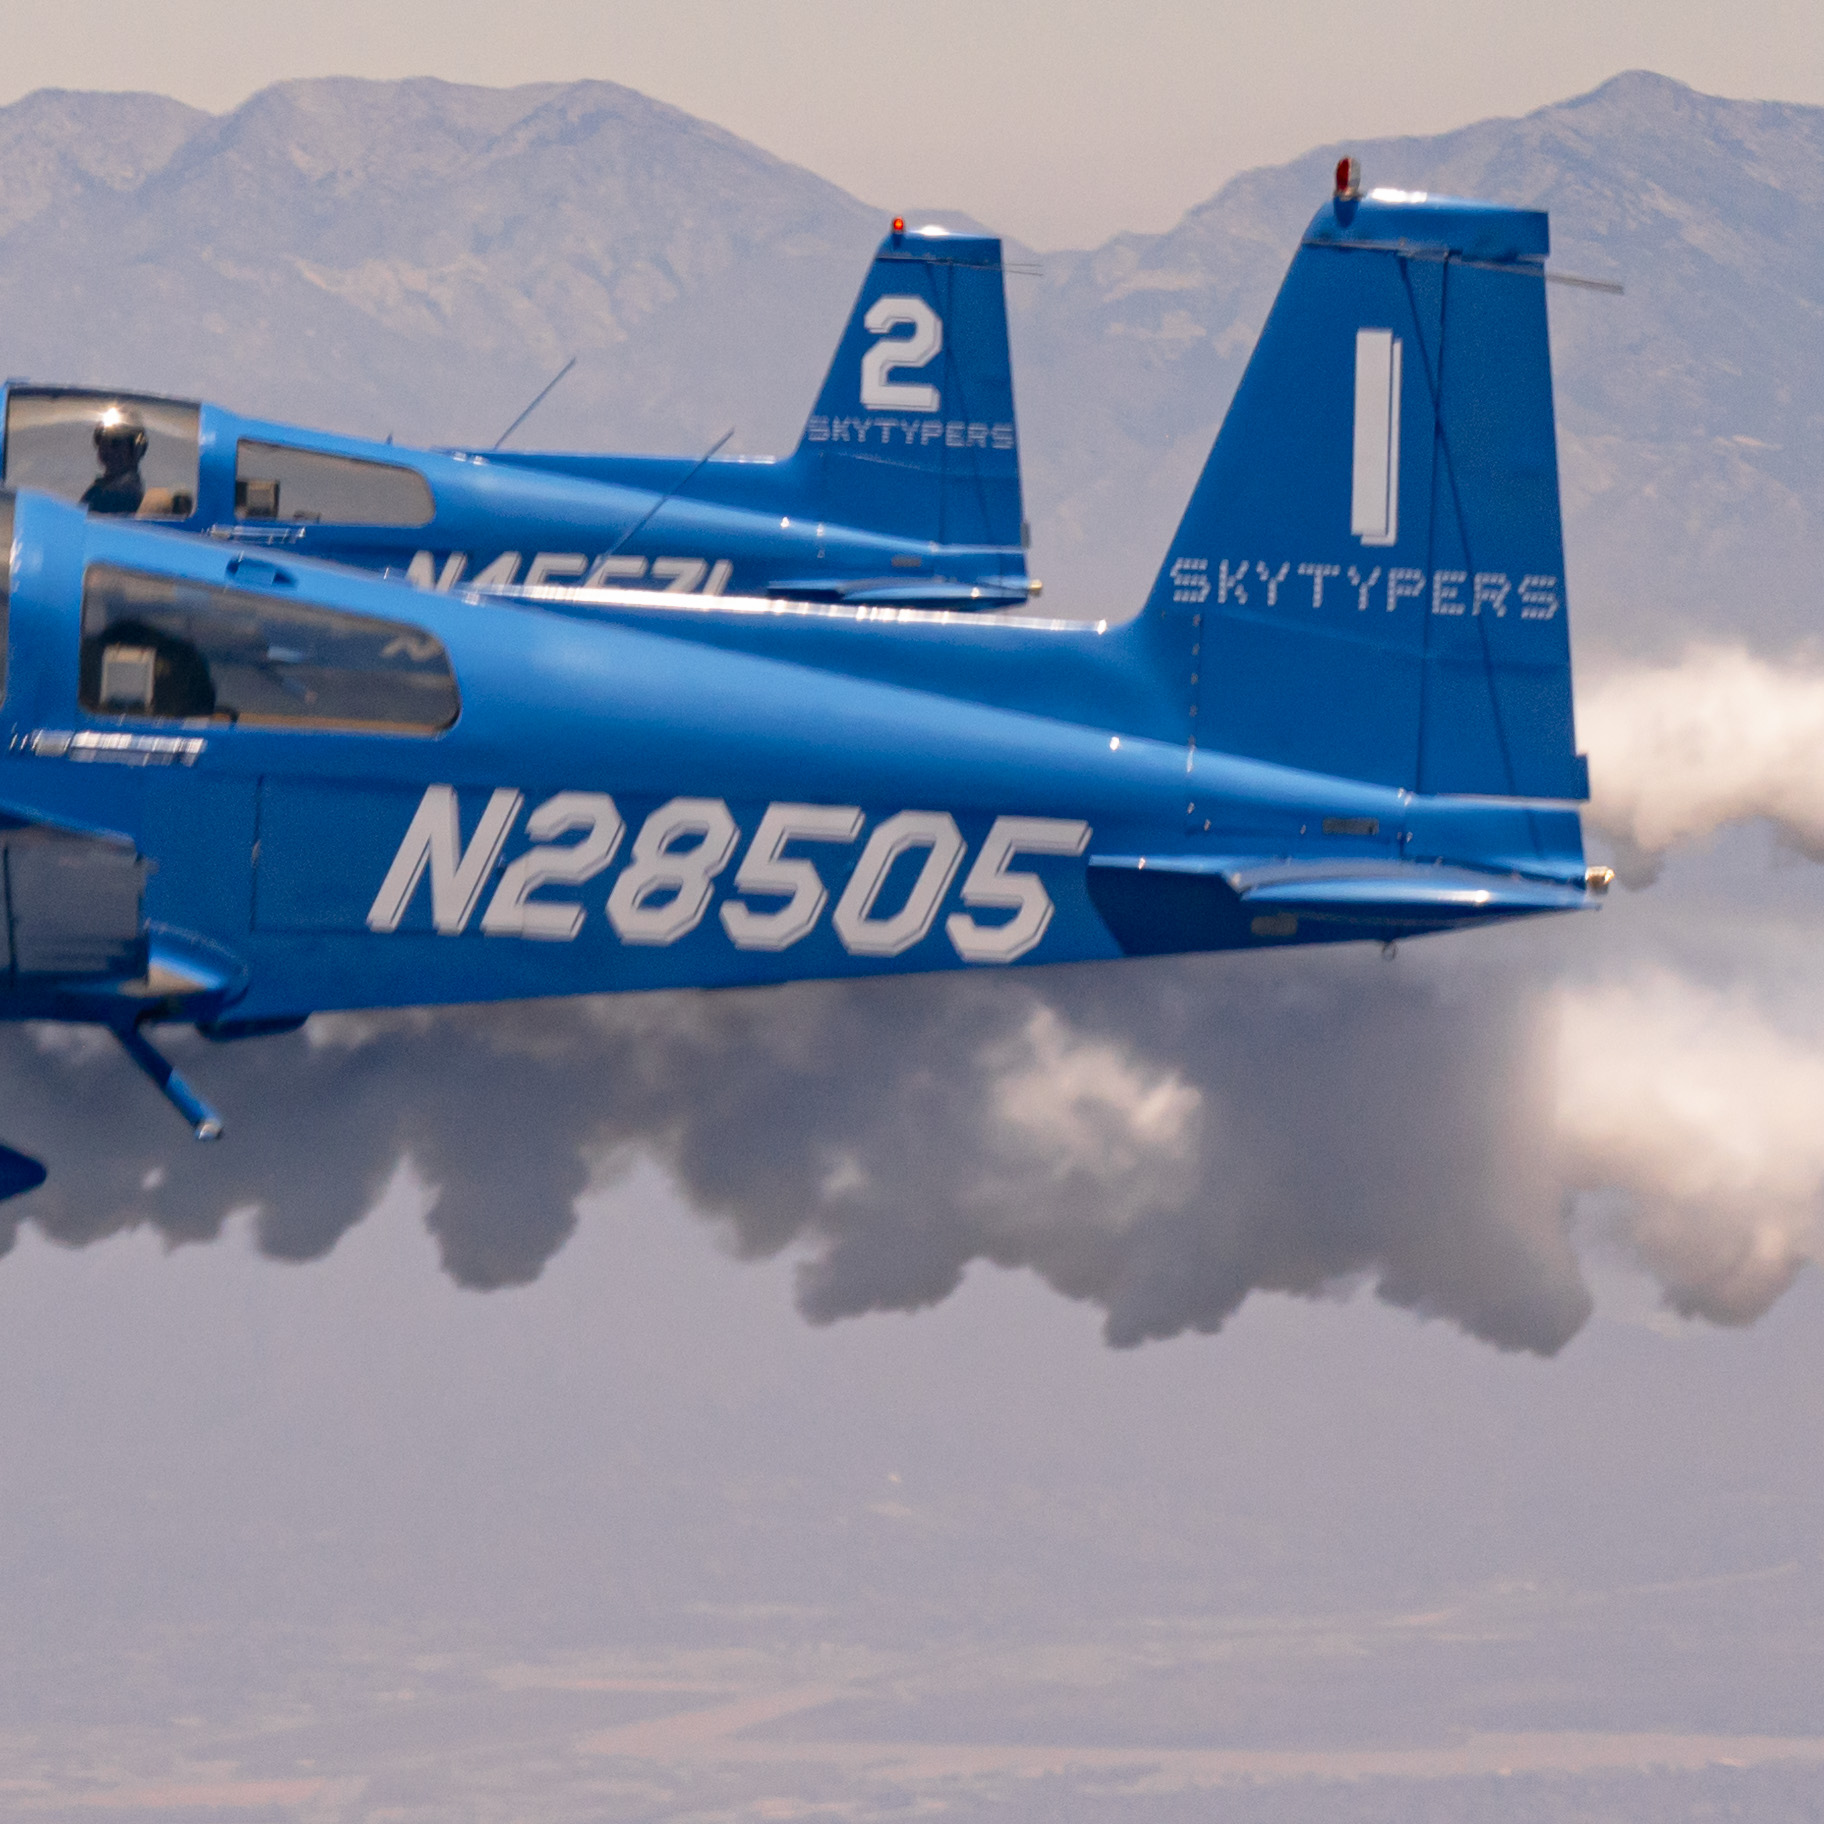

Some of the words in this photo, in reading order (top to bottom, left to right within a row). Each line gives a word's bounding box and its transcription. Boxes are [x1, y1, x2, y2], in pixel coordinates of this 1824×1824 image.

[860, 294, 943, 412] 2
[807, 416, 1015, 449] SKYTYPERS
[1170, 558, 1558, 619] SKYTYPERS
[366, 784, 1094, 963] N28505
